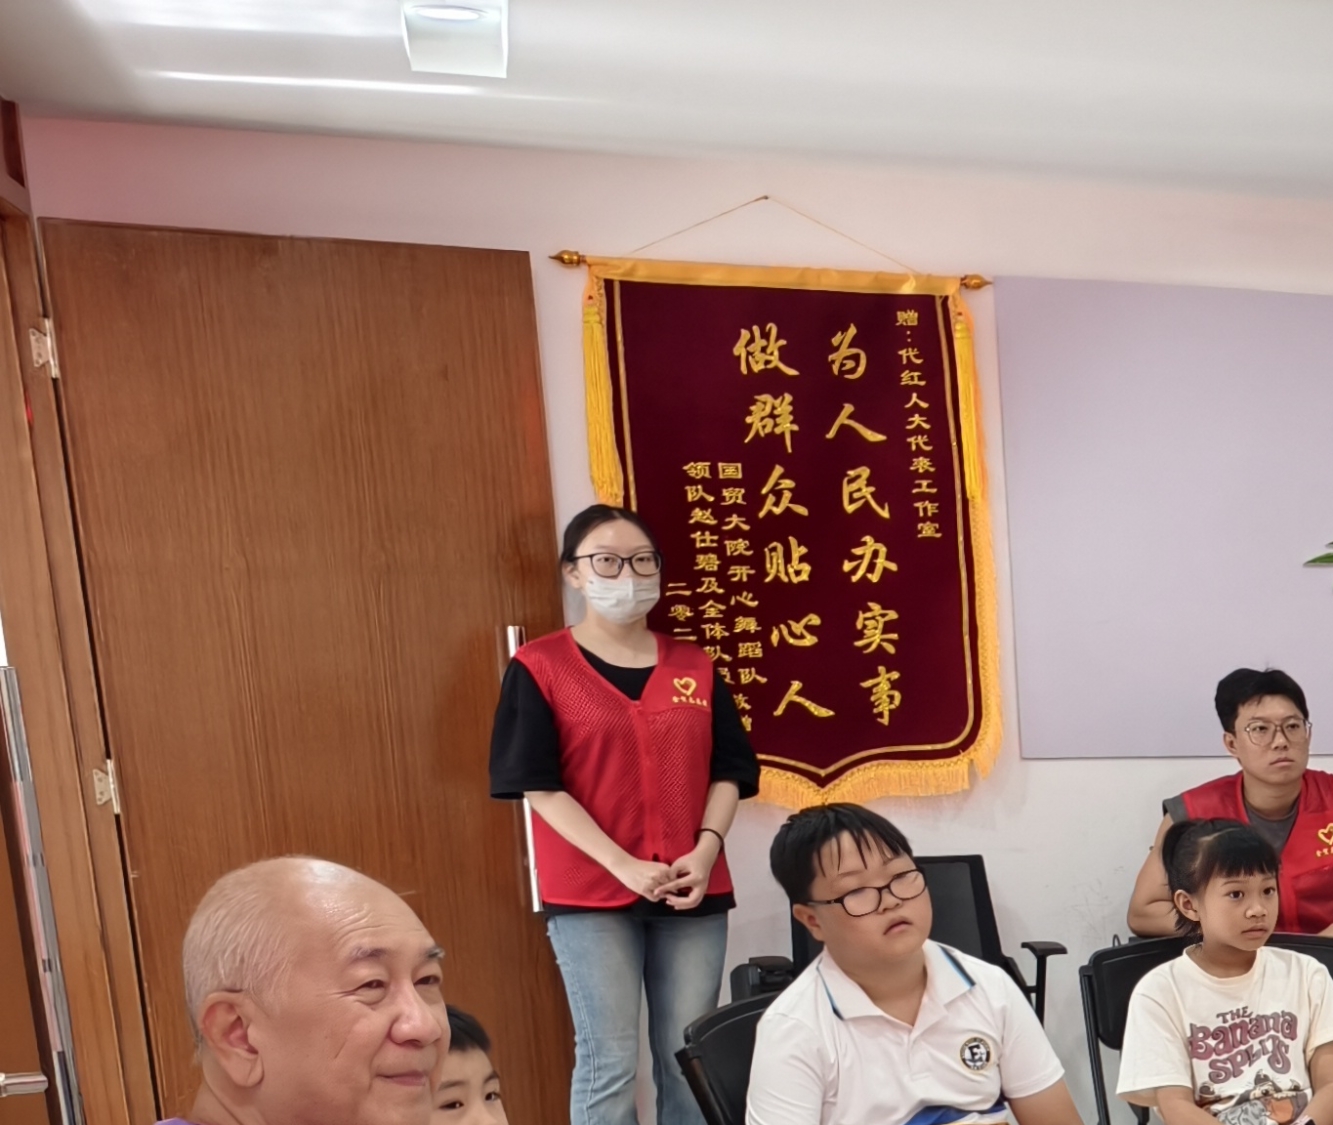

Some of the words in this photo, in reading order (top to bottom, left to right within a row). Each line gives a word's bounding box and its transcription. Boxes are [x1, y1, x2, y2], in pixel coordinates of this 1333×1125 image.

[718, 462, 768, 684] 国贸大院开心舞蹈队
[732, 322, 834, 719] 做群众贴心人
[825, 322, 902, 727] 为人民办实事
[1208, 1034, 1291, 1084] SPLITS
[1216, 1006, 1254, 1024] THE
